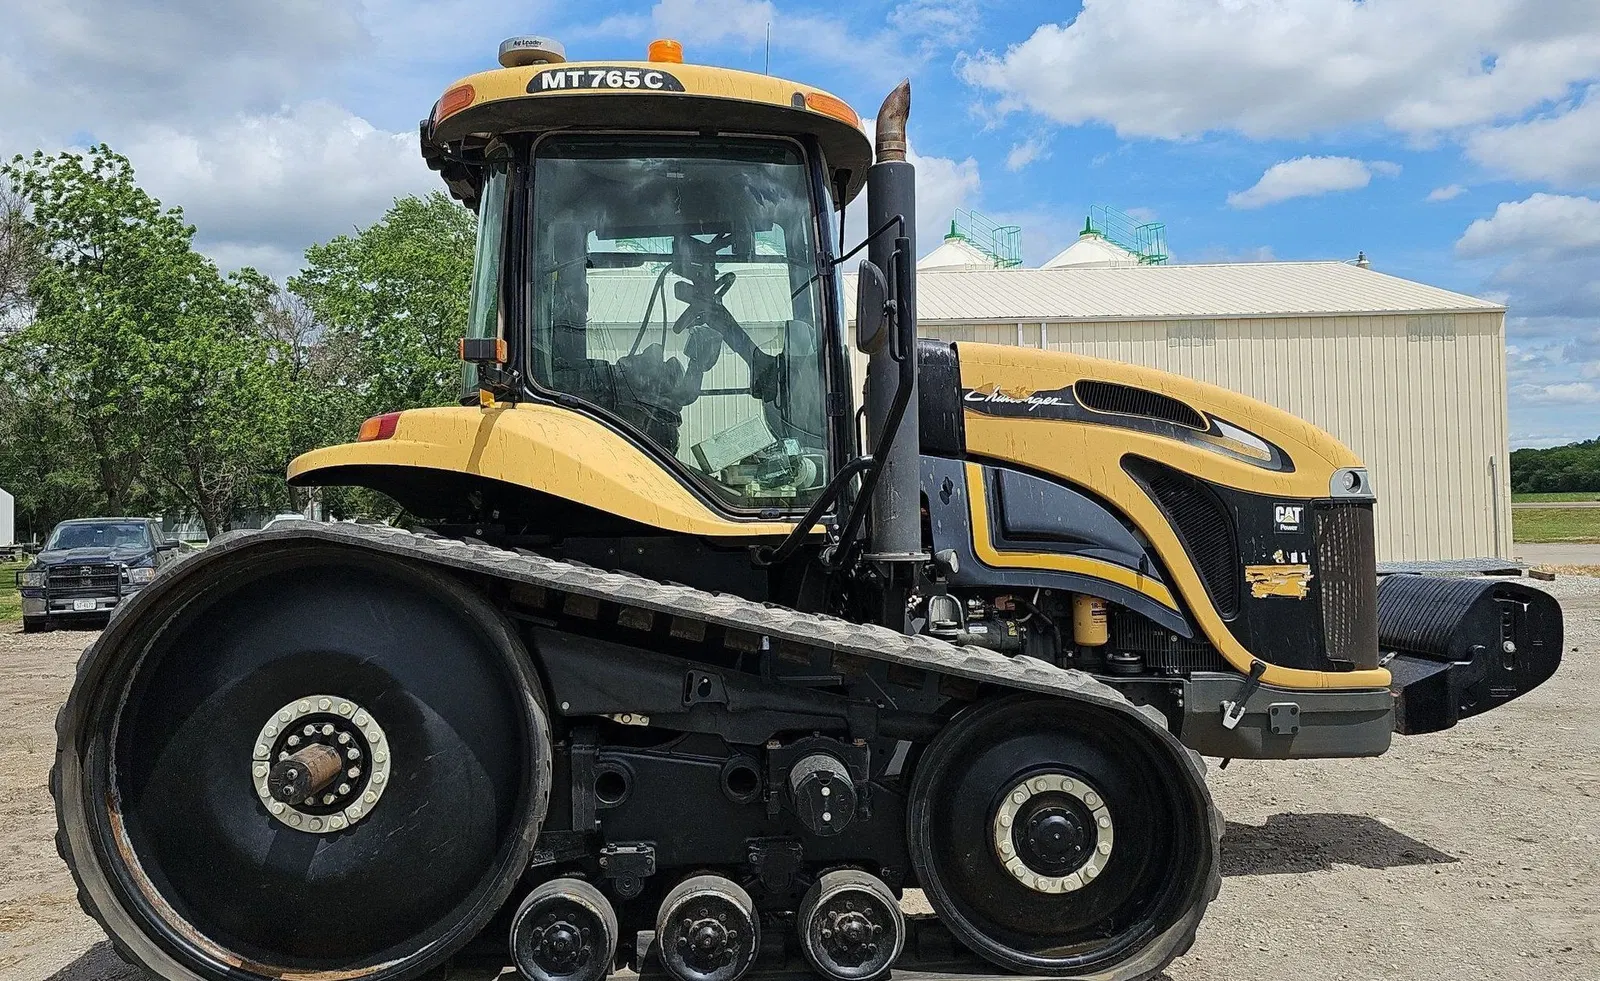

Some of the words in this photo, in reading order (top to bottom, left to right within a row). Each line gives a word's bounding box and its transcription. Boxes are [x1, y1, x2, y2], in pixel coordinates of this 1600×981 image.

[541, 71, 585, 89] MT
[1275, 506, 1304, 523] CAT
[1280, 523, 1298, 531] Power
